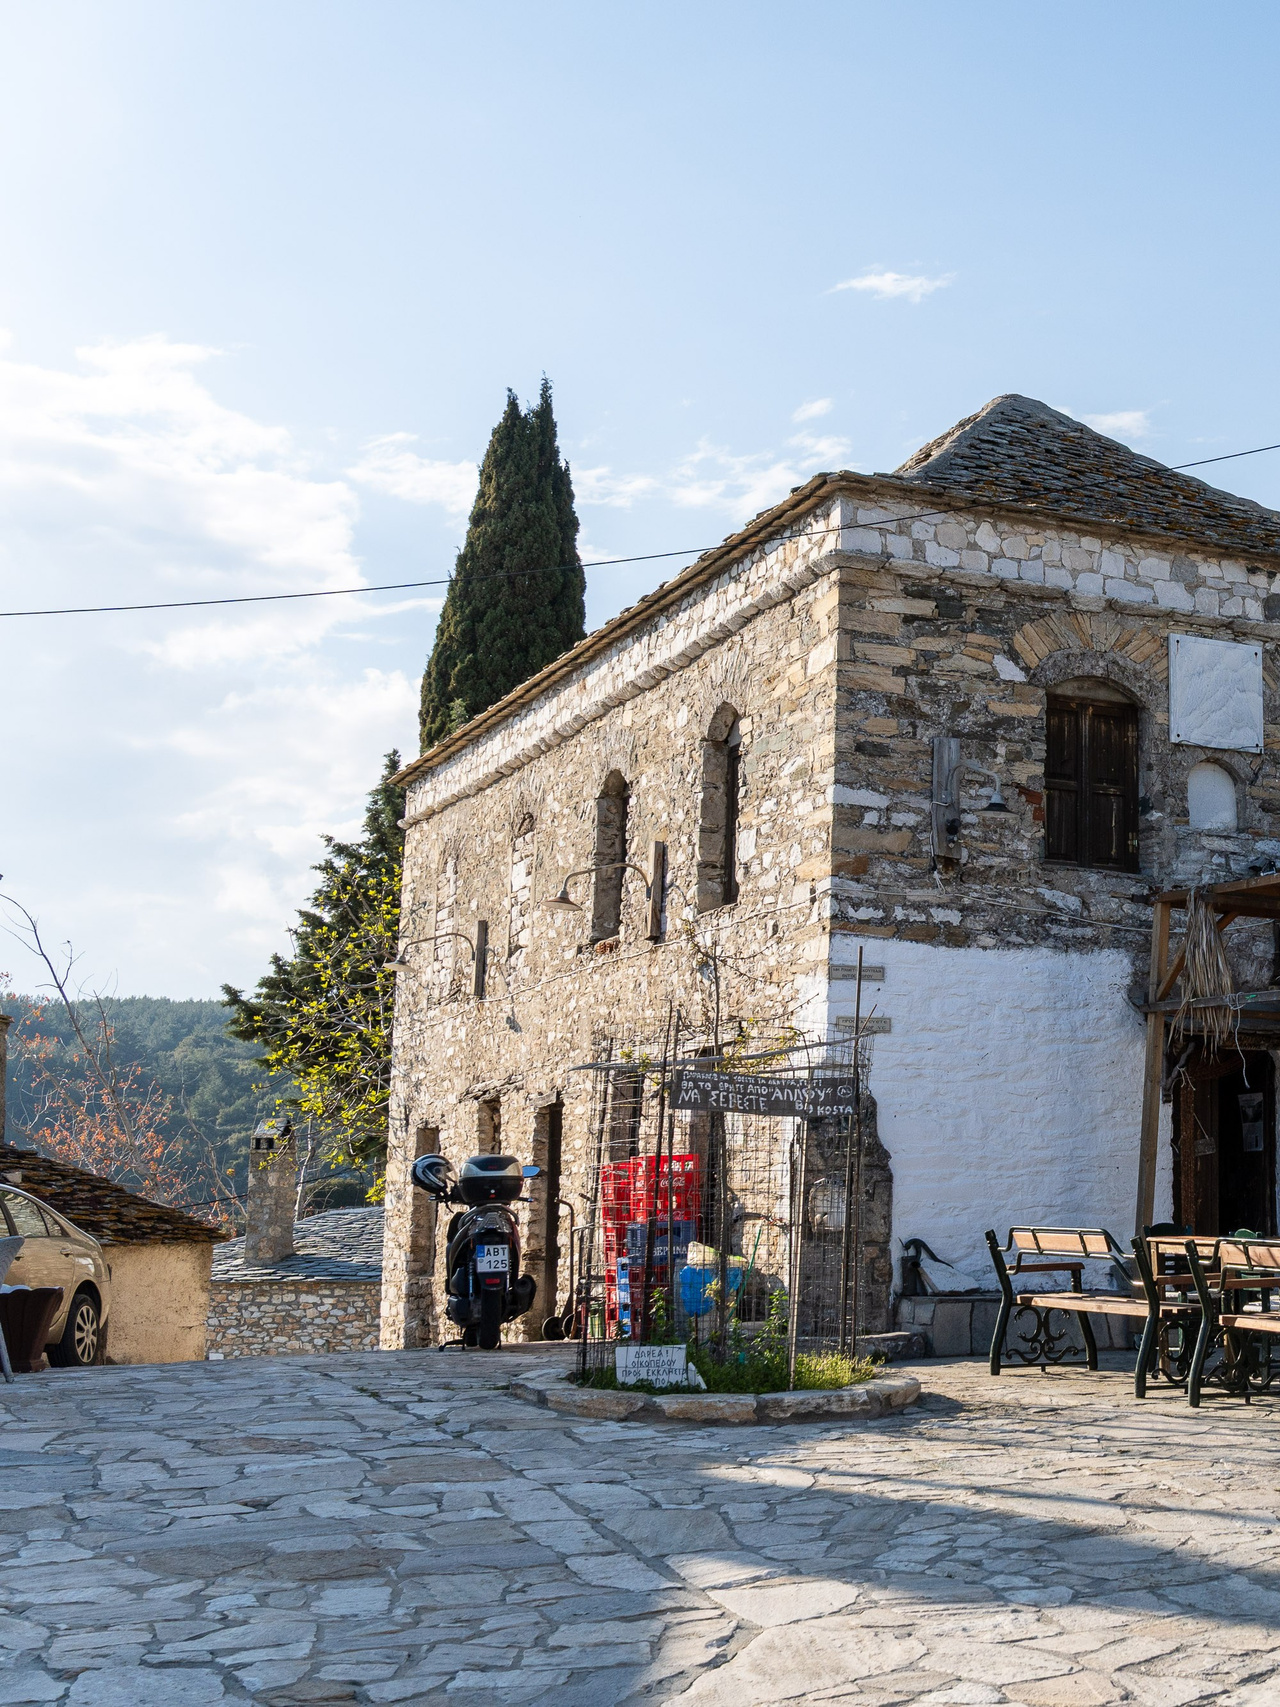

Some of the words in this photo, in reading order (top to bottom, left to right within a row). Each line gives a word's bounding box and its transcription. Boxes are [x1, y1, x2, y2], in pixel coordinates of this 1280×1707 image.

[681, 1080, 694, 1089] ΘΑ
[697, 1081, 712, 1090] ΤΟ
[678, 1089, 701, 1104] ΝΑ
[817, 1105, 853, 1116] KOSTA
[485, 1247, 507, 1257] ABT
[486, 1259, 508, 1269] 125
